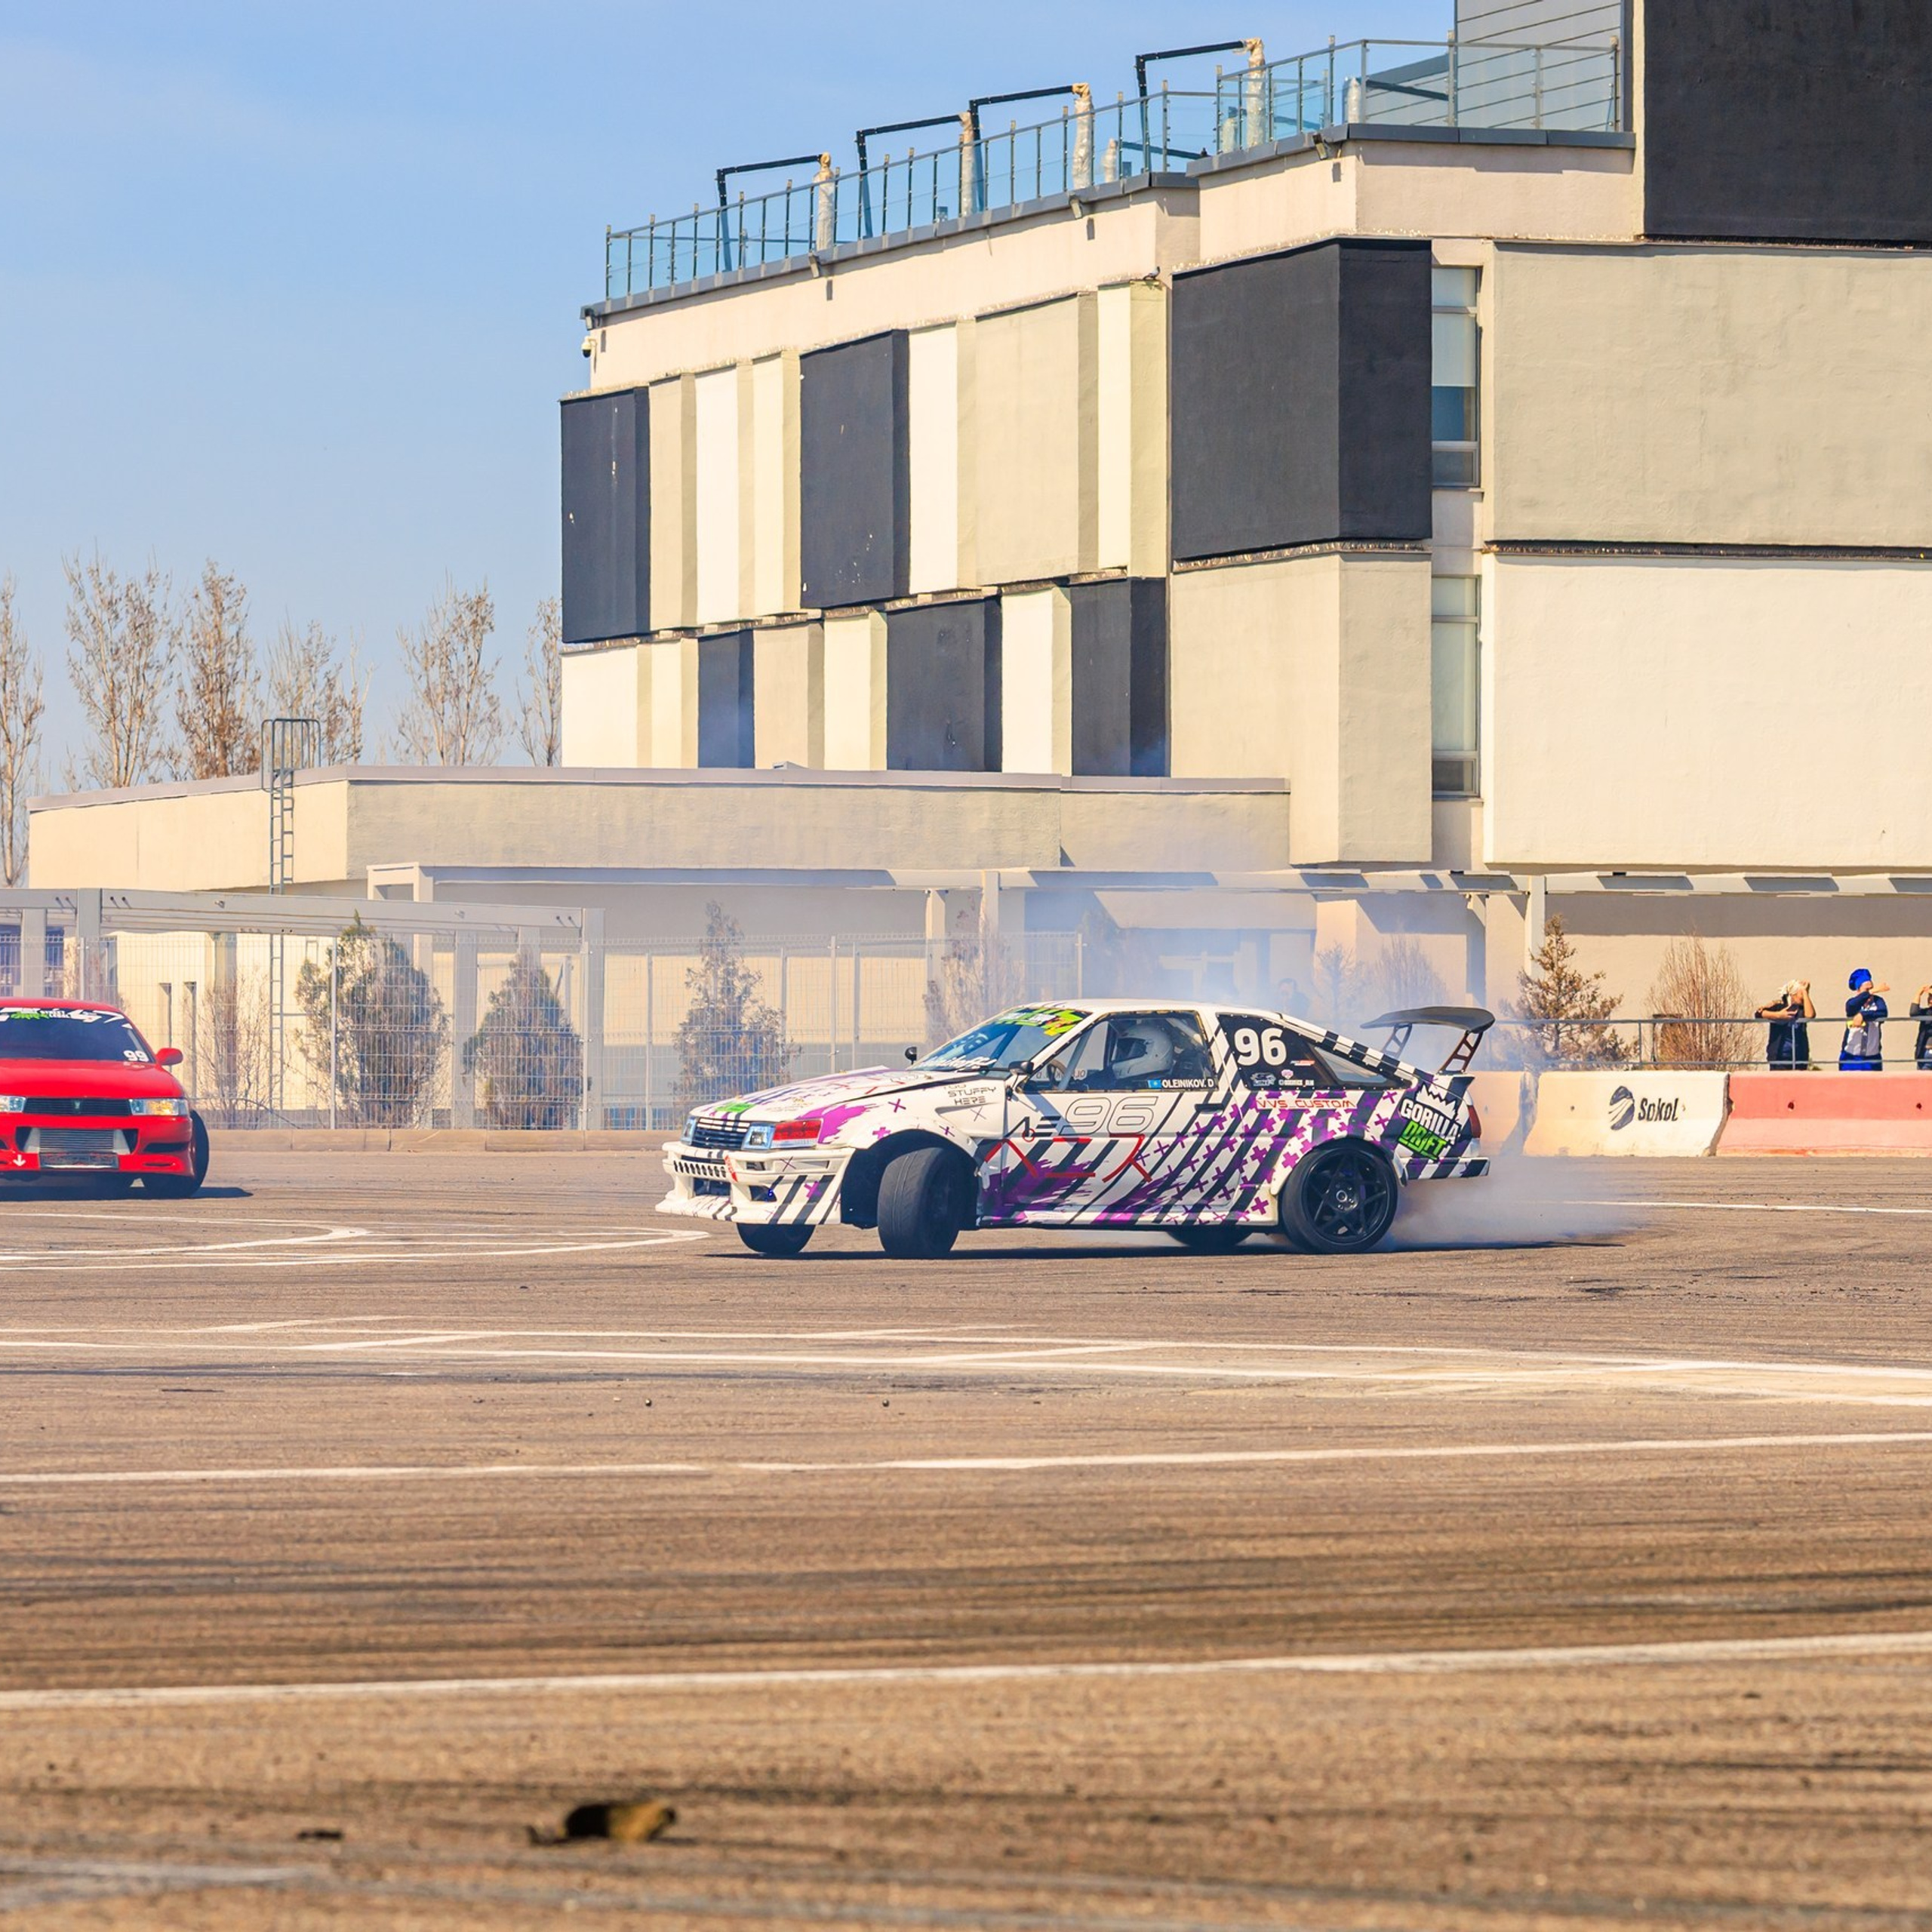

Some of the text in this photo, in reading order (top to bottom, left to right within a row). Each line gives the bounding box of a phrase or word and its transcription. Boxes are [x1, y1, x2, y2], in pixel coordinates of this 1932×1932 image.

[123, 1050, 149, 1062] 99
[1234, 1027, 1287, 1066] 96
[947, 1087, 997, 1097] STUFFY
[1208, 1078, 1214, 1088] D
[953, 1096, 986, 1106] HERE
[1638, 1097, 1679, 1121] Sokol
[1059, 1096, 1159, 1135] 96
[1400, 1098, 1460, 1145] GORILLA
[1399, 1120, 1447, 1159] DRIFT
